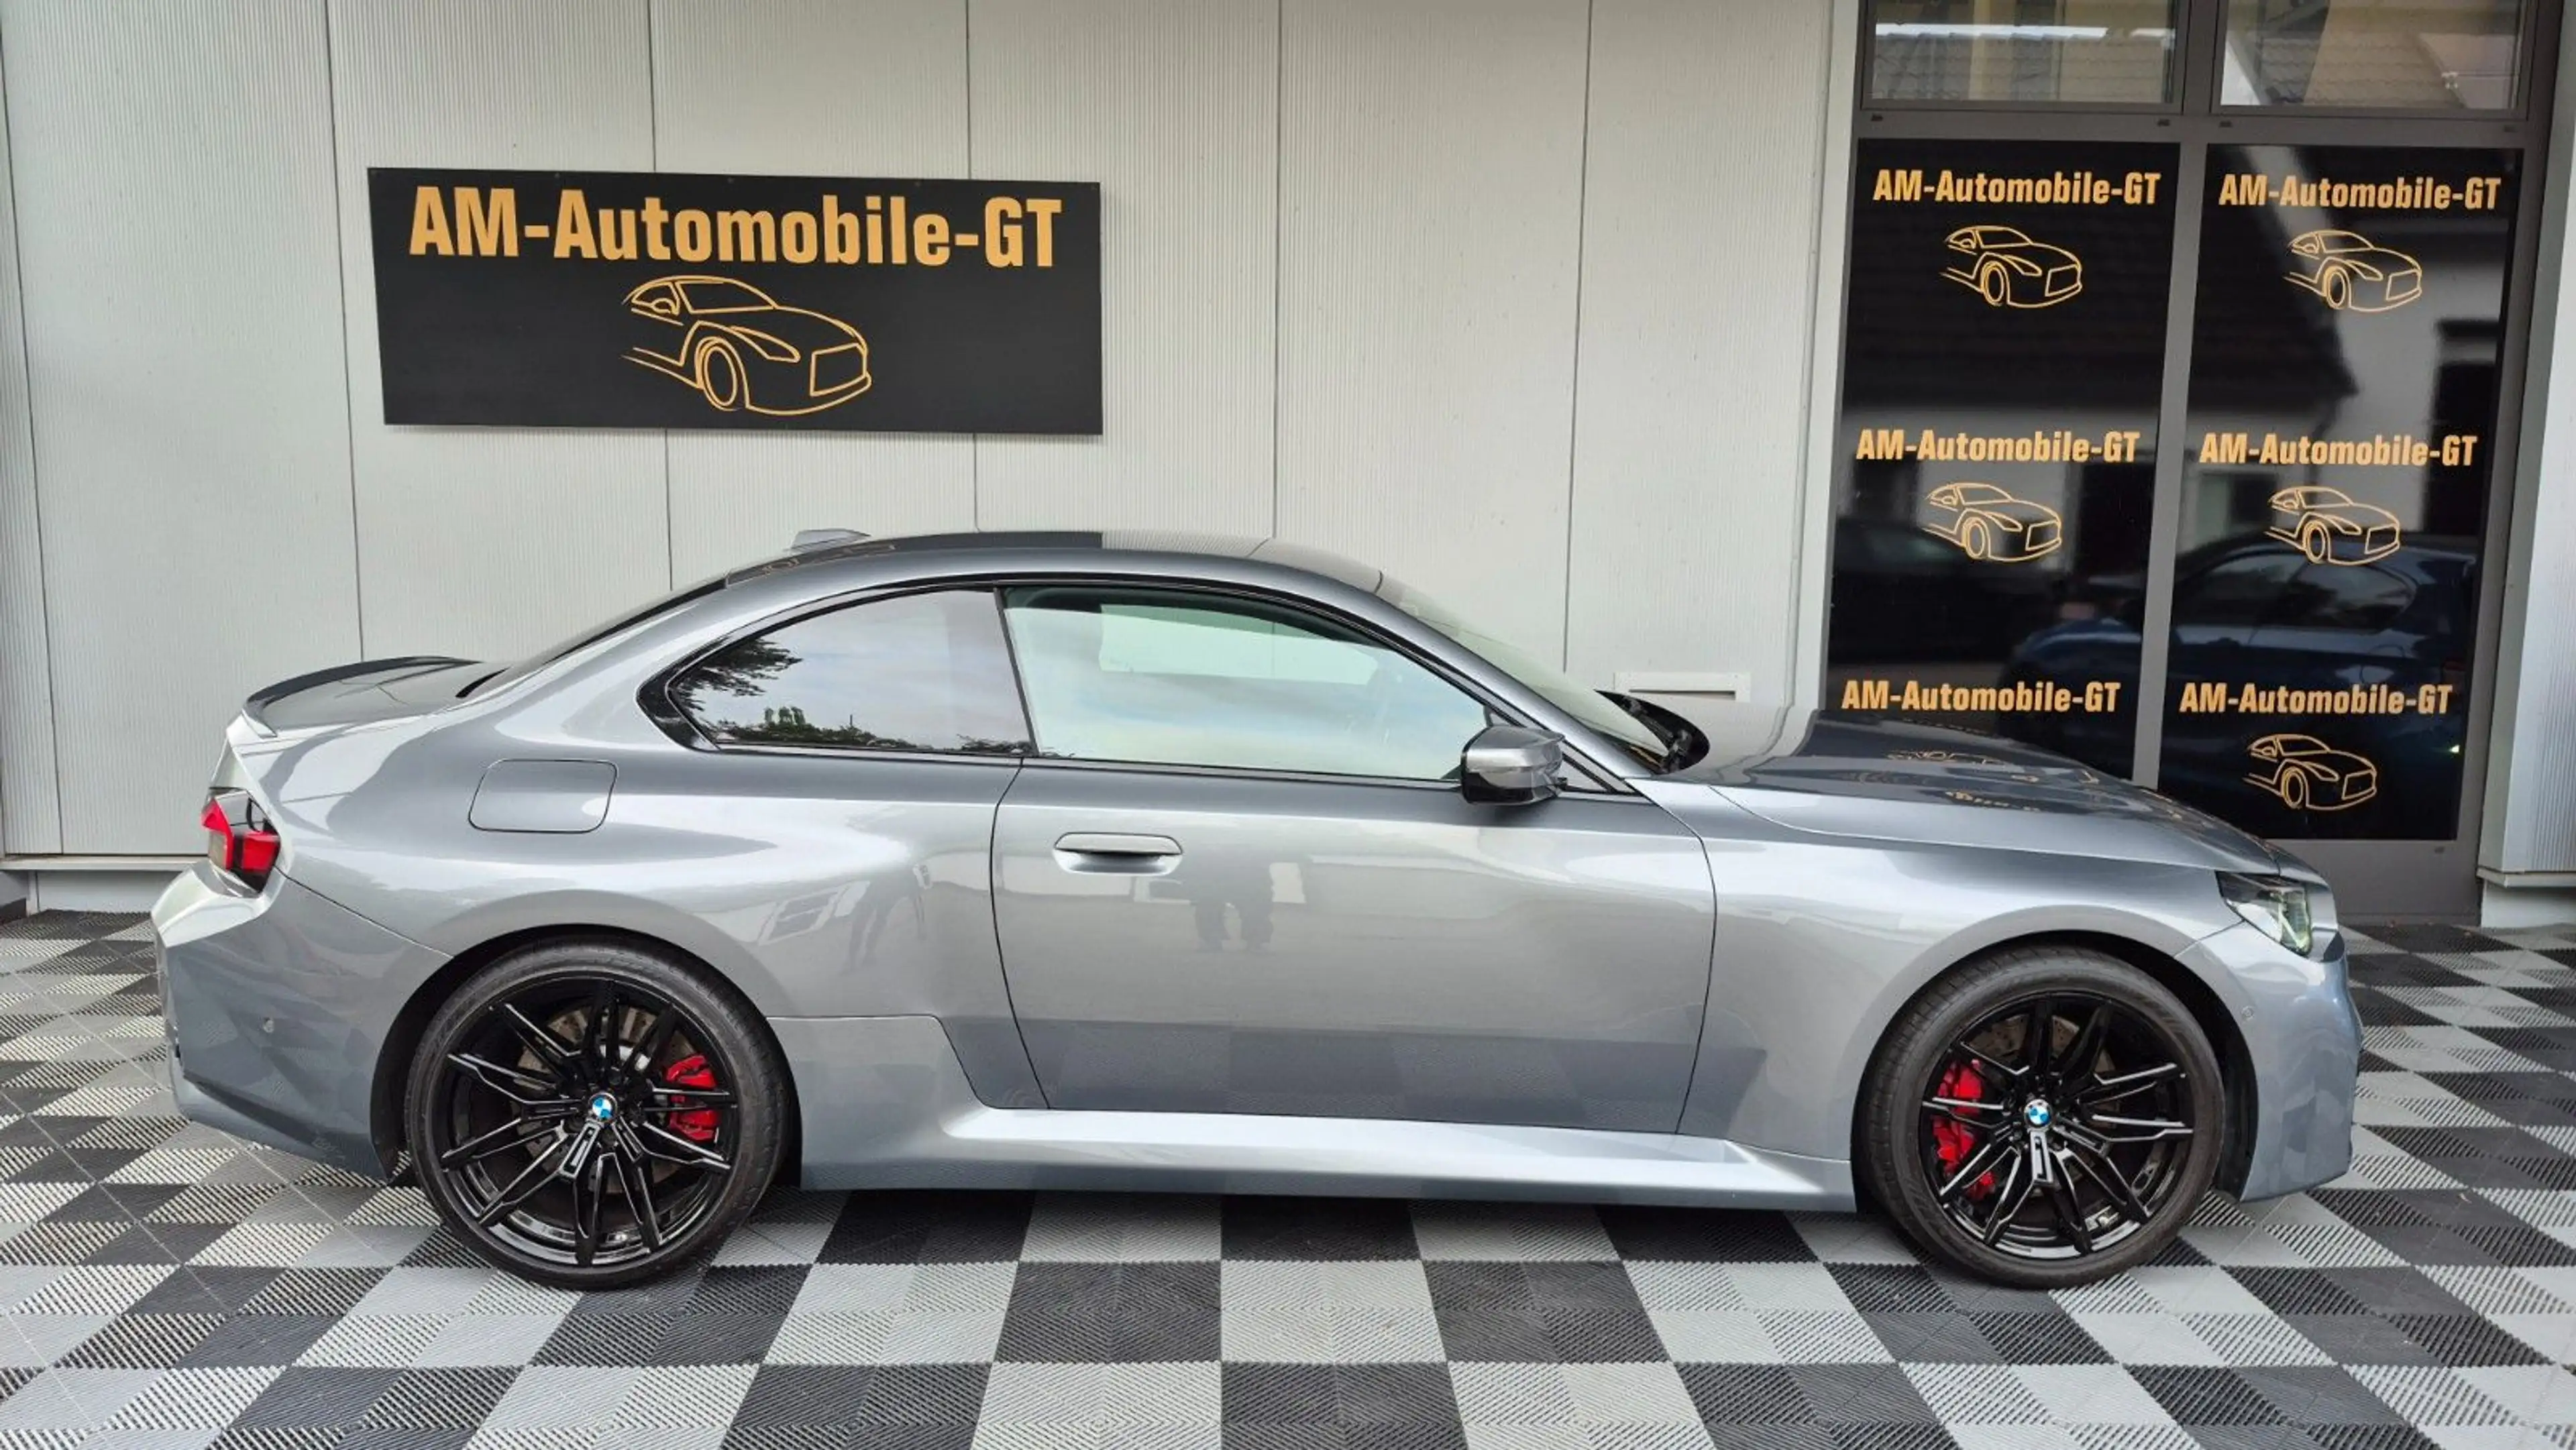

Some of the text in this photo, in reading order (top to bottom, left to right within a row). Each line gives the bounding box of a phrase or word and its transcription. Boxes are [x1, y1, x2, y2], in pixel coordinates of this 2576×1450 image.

[1874, 169, 2161, 205] AM-Automobile-GT
[2219, 174, 2501, 209] AM-Automobile-GT
[410, 186, 1062, 267] AM-Automobile-GT
[1856, 429, 2141, 463] AM-Automobile-GT
[2200, 433, 2477, 465] AM-Automobile-GT
[1842, 680, 2120, 712] AM-Automobile-GT
[2180, 683, 2452, 714] AM-Automobile-GT
